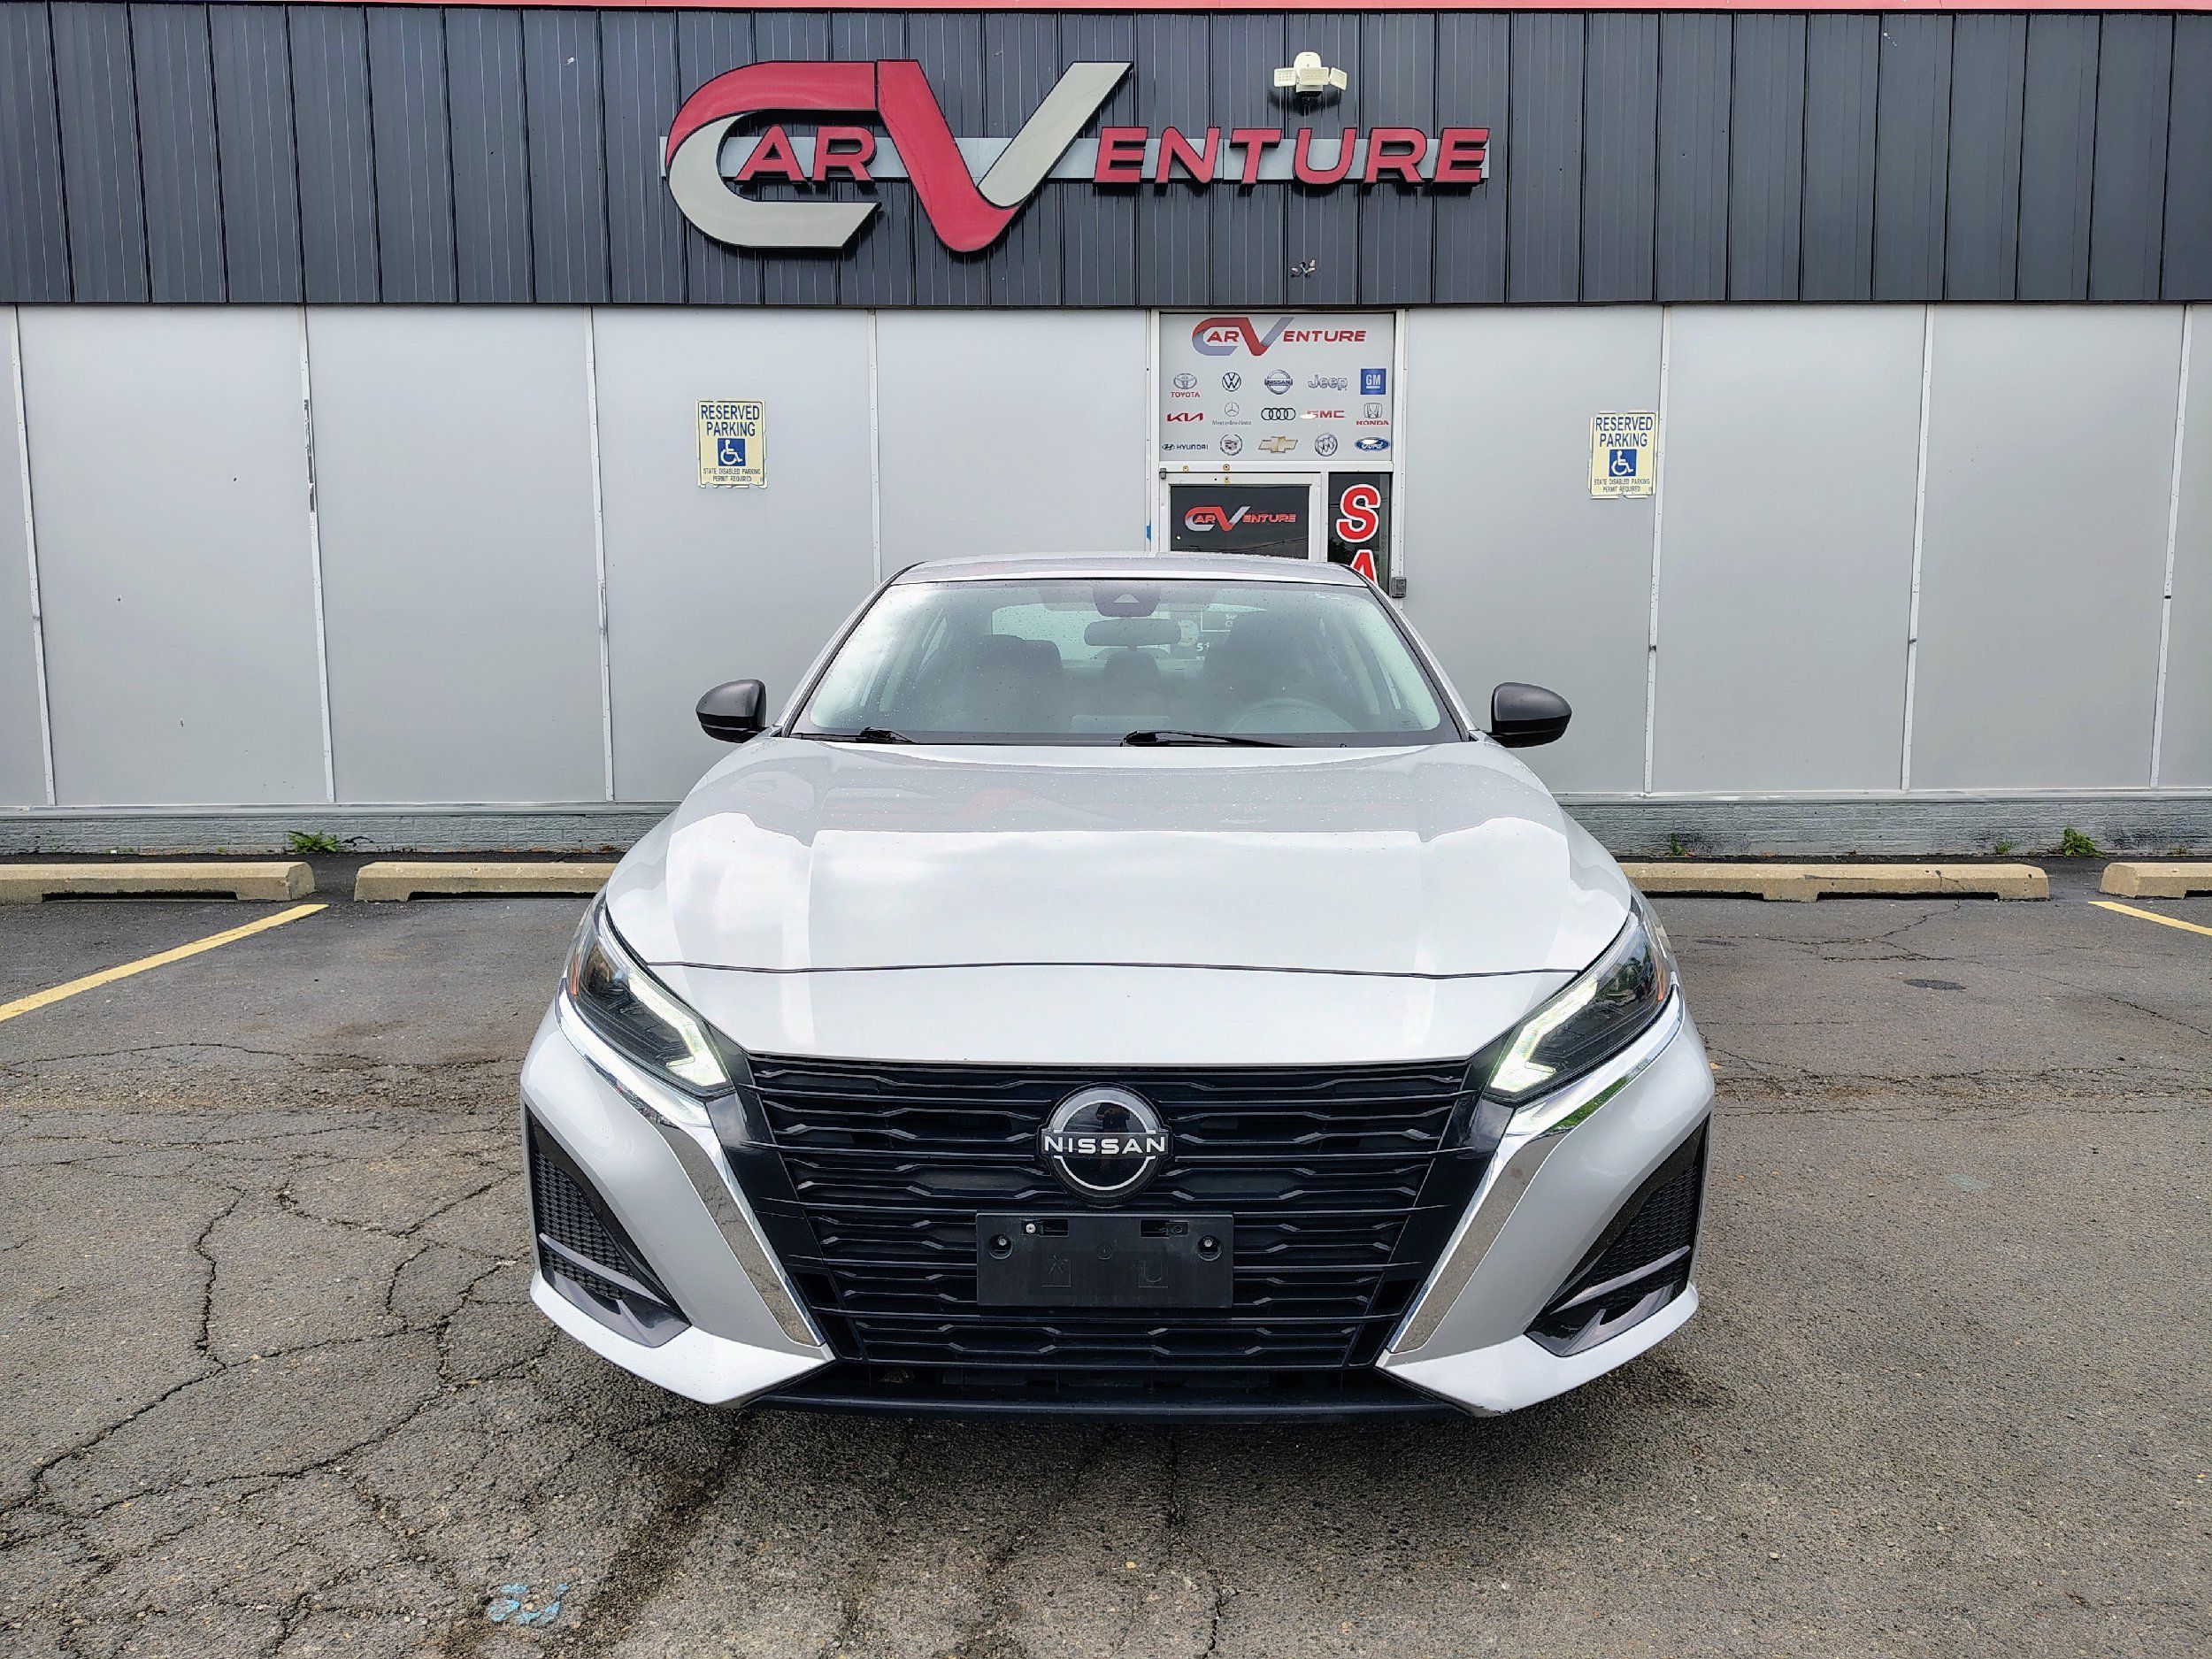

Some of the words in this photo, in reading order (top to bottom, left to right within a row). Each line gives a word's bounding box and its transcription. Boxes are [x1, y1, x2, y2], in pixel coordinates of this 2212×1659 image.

[1308, 373, 1348, 391] Jeep
[1365, 374, 1381, 386] GM
[700, 404, 760, 420] RESERVED
[706, 421, 756, 437] PARKING
[1595, 416, 1654, 431] RESERVED
[1599, 433, 1647, 447] PARKING
[1044, 1135, 1165, 1155] NISSAN
